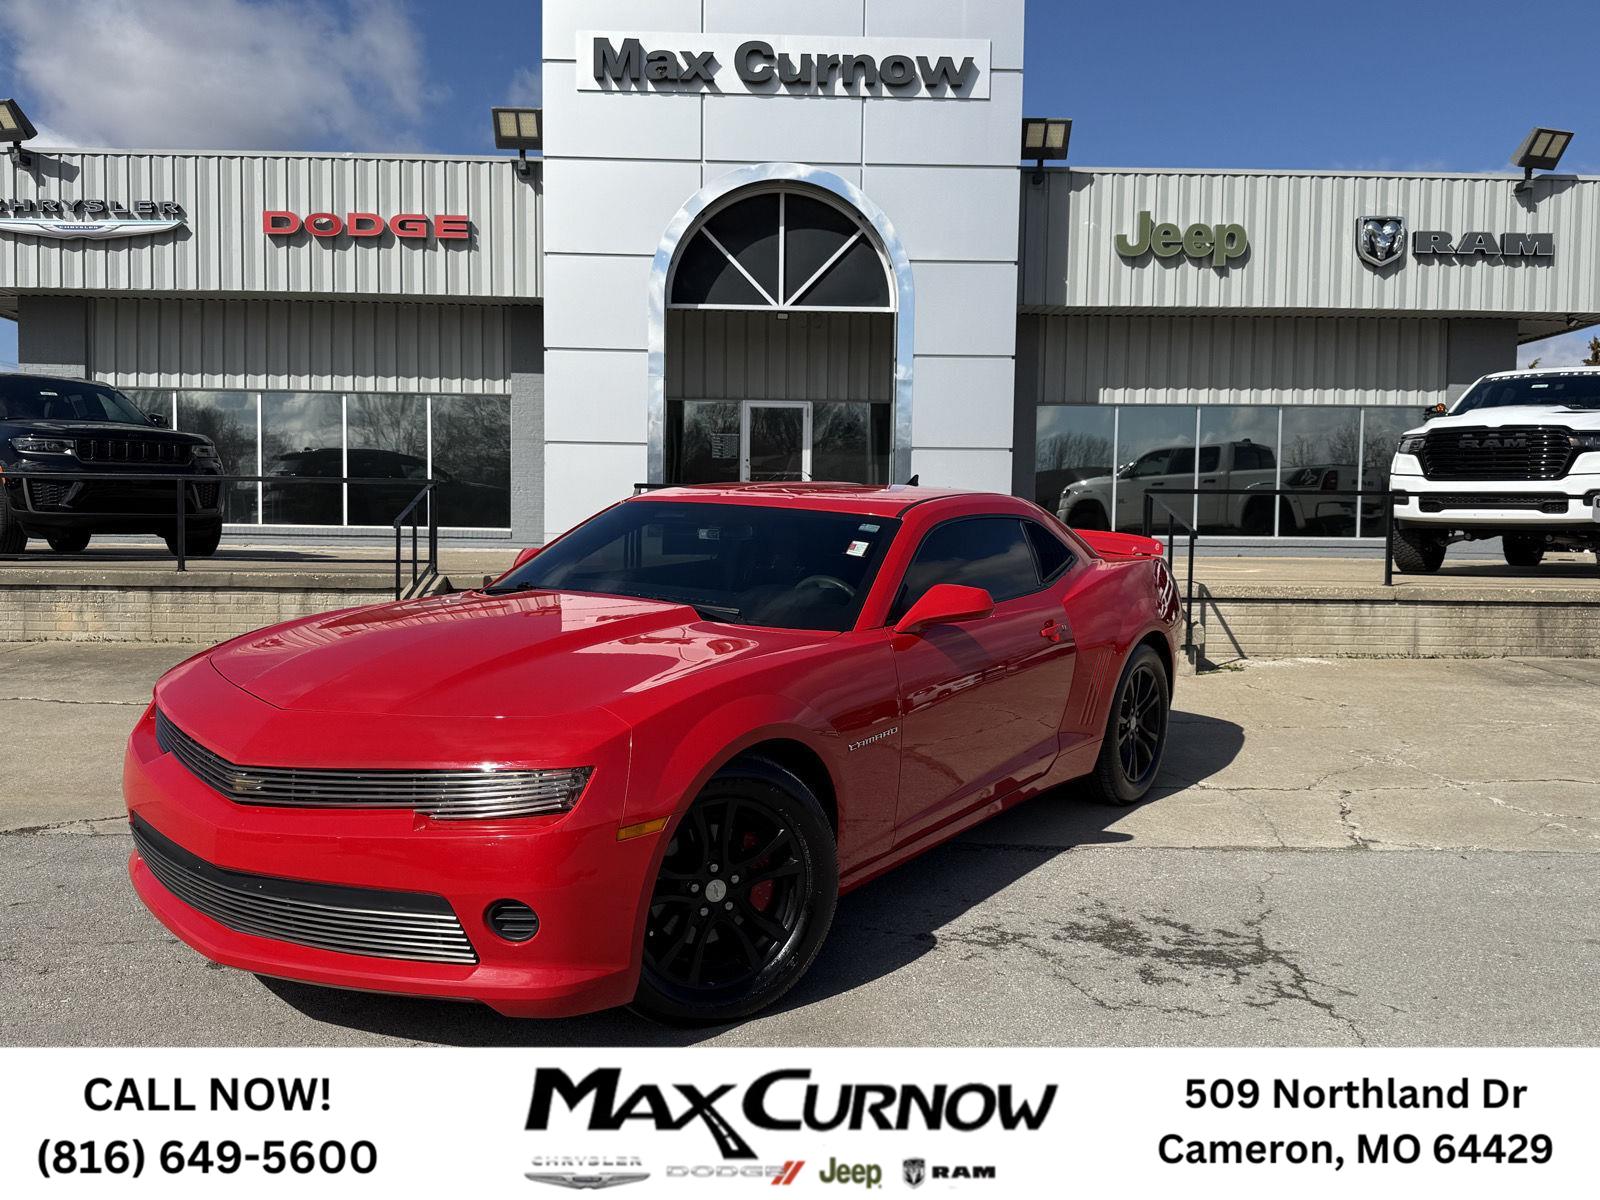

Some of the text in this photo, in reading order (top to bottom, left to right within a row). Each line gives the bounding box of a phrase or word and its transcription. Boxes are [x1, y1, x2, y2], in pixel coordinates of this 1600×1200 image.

[593, 37, 975, 88] Max Curnow
[0, 199, 182, 214] HRYSLER
[263, 211, 469, 239] DODGE
[1114, 211, 1248, 267] Jeep
[1413, 231, 1554, 256] RAM
[1458, 438, 1527, 449] RAM
[848, 727, 898, 751] CAMARO
